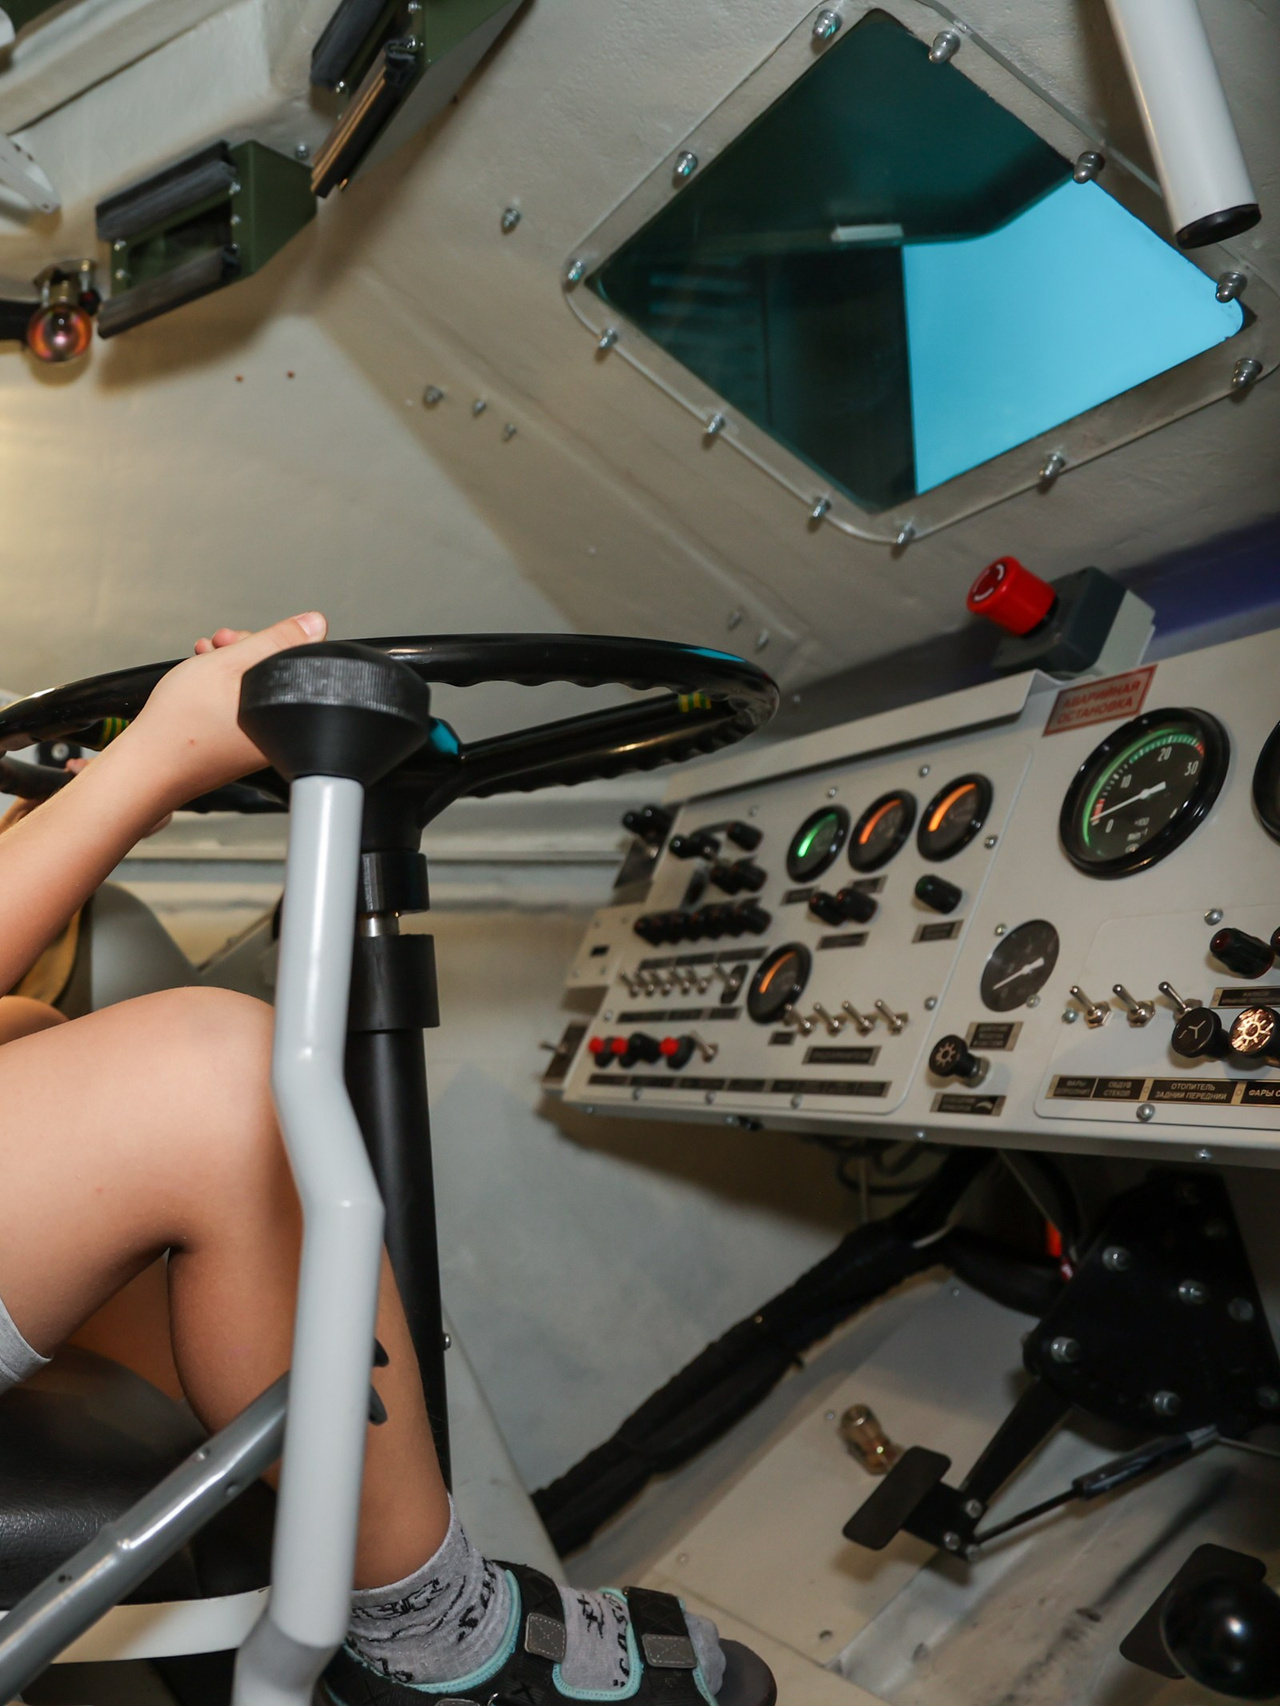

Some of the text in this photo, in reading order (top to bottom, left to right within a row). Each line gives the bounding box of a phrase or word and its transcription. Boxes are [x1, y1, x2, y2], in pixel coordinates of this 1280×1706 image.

[1057, 697, 1133, 723] ОСТАНОВКА
[1158, 747, 1172, 762] 20
[1184, 761, 1199, 776] 30
[1121, 774, 1132, 789] 10
[1106, 819, 1114, 833] 0
[1171, 1083, 1216, 1092] ОТОПИТЕЛЬ
[1248, 1089, 1274, 1097] ФАРЫ
